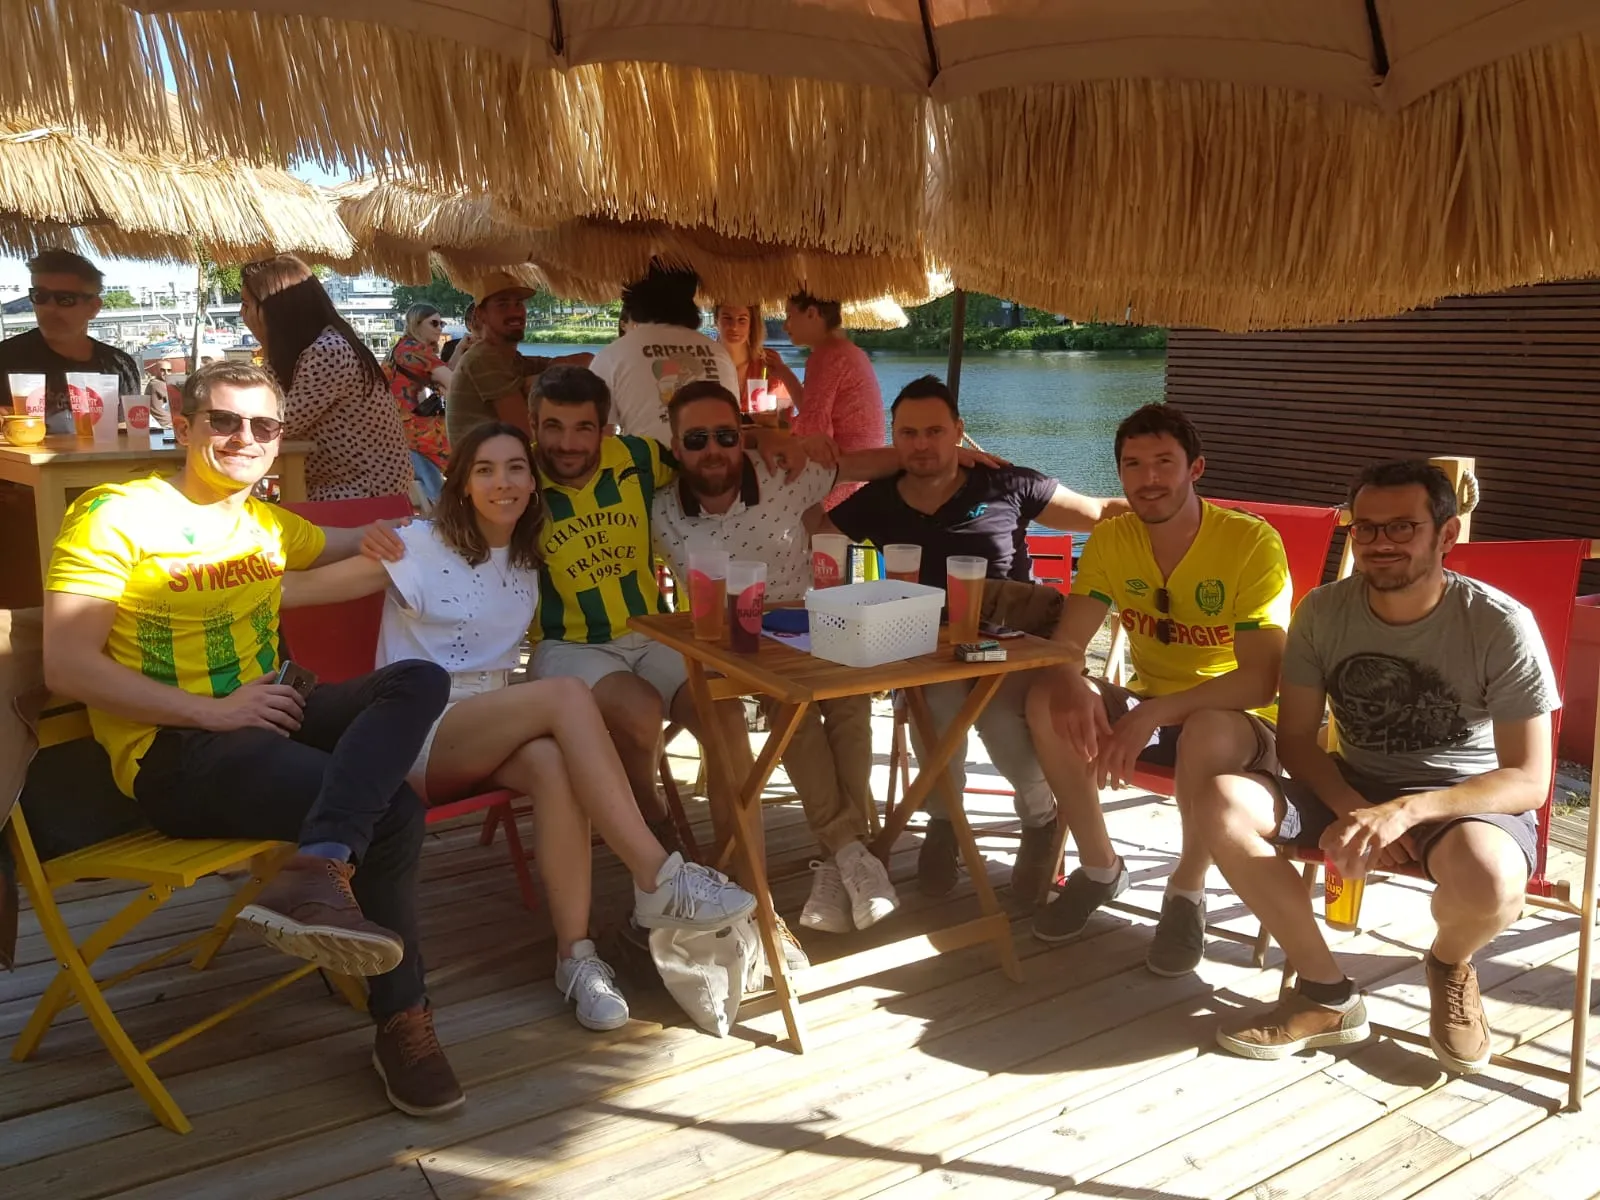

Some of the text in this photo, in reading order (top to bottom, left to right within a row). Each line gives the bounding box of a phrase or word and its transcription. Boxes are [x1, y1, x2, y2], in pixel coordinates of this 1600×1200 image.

[642, 343, 715, 358] CRITICAL
[545, 511, 640, 554] CHAMPION
[583, 530, 609, 549] DE
[168, 552, 285, 592] SYNERGIE
[566, 545, 637, 579] FRANCE
[589, 563, 622, 584] 1995
